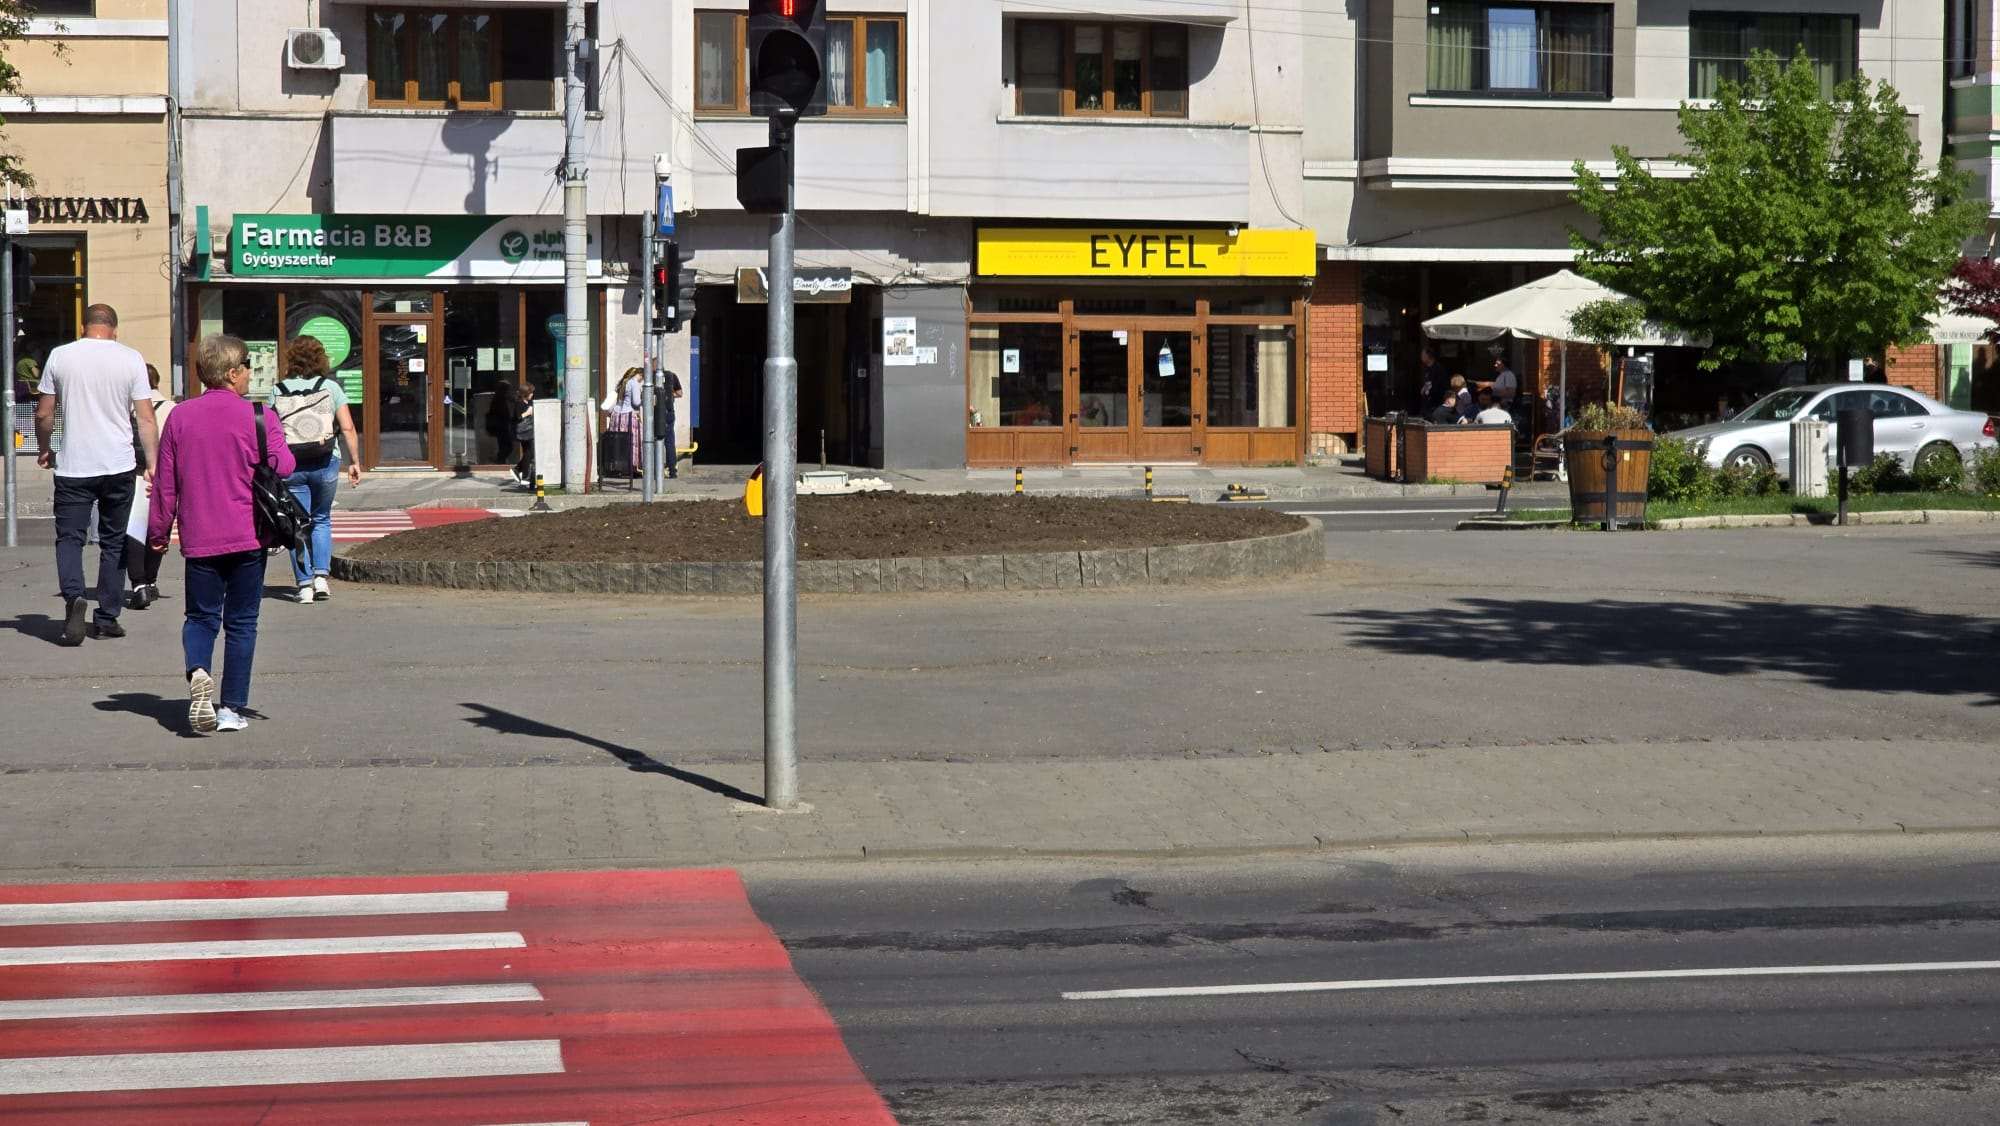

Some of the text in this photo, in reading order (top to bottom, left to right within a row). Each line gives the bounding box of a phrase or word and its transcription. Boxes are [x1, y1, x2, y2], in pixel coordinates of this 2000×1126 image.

[241, 222, 432, 247] Farmacia B&B
[1090, 234, 1207, 268] EYFEL
